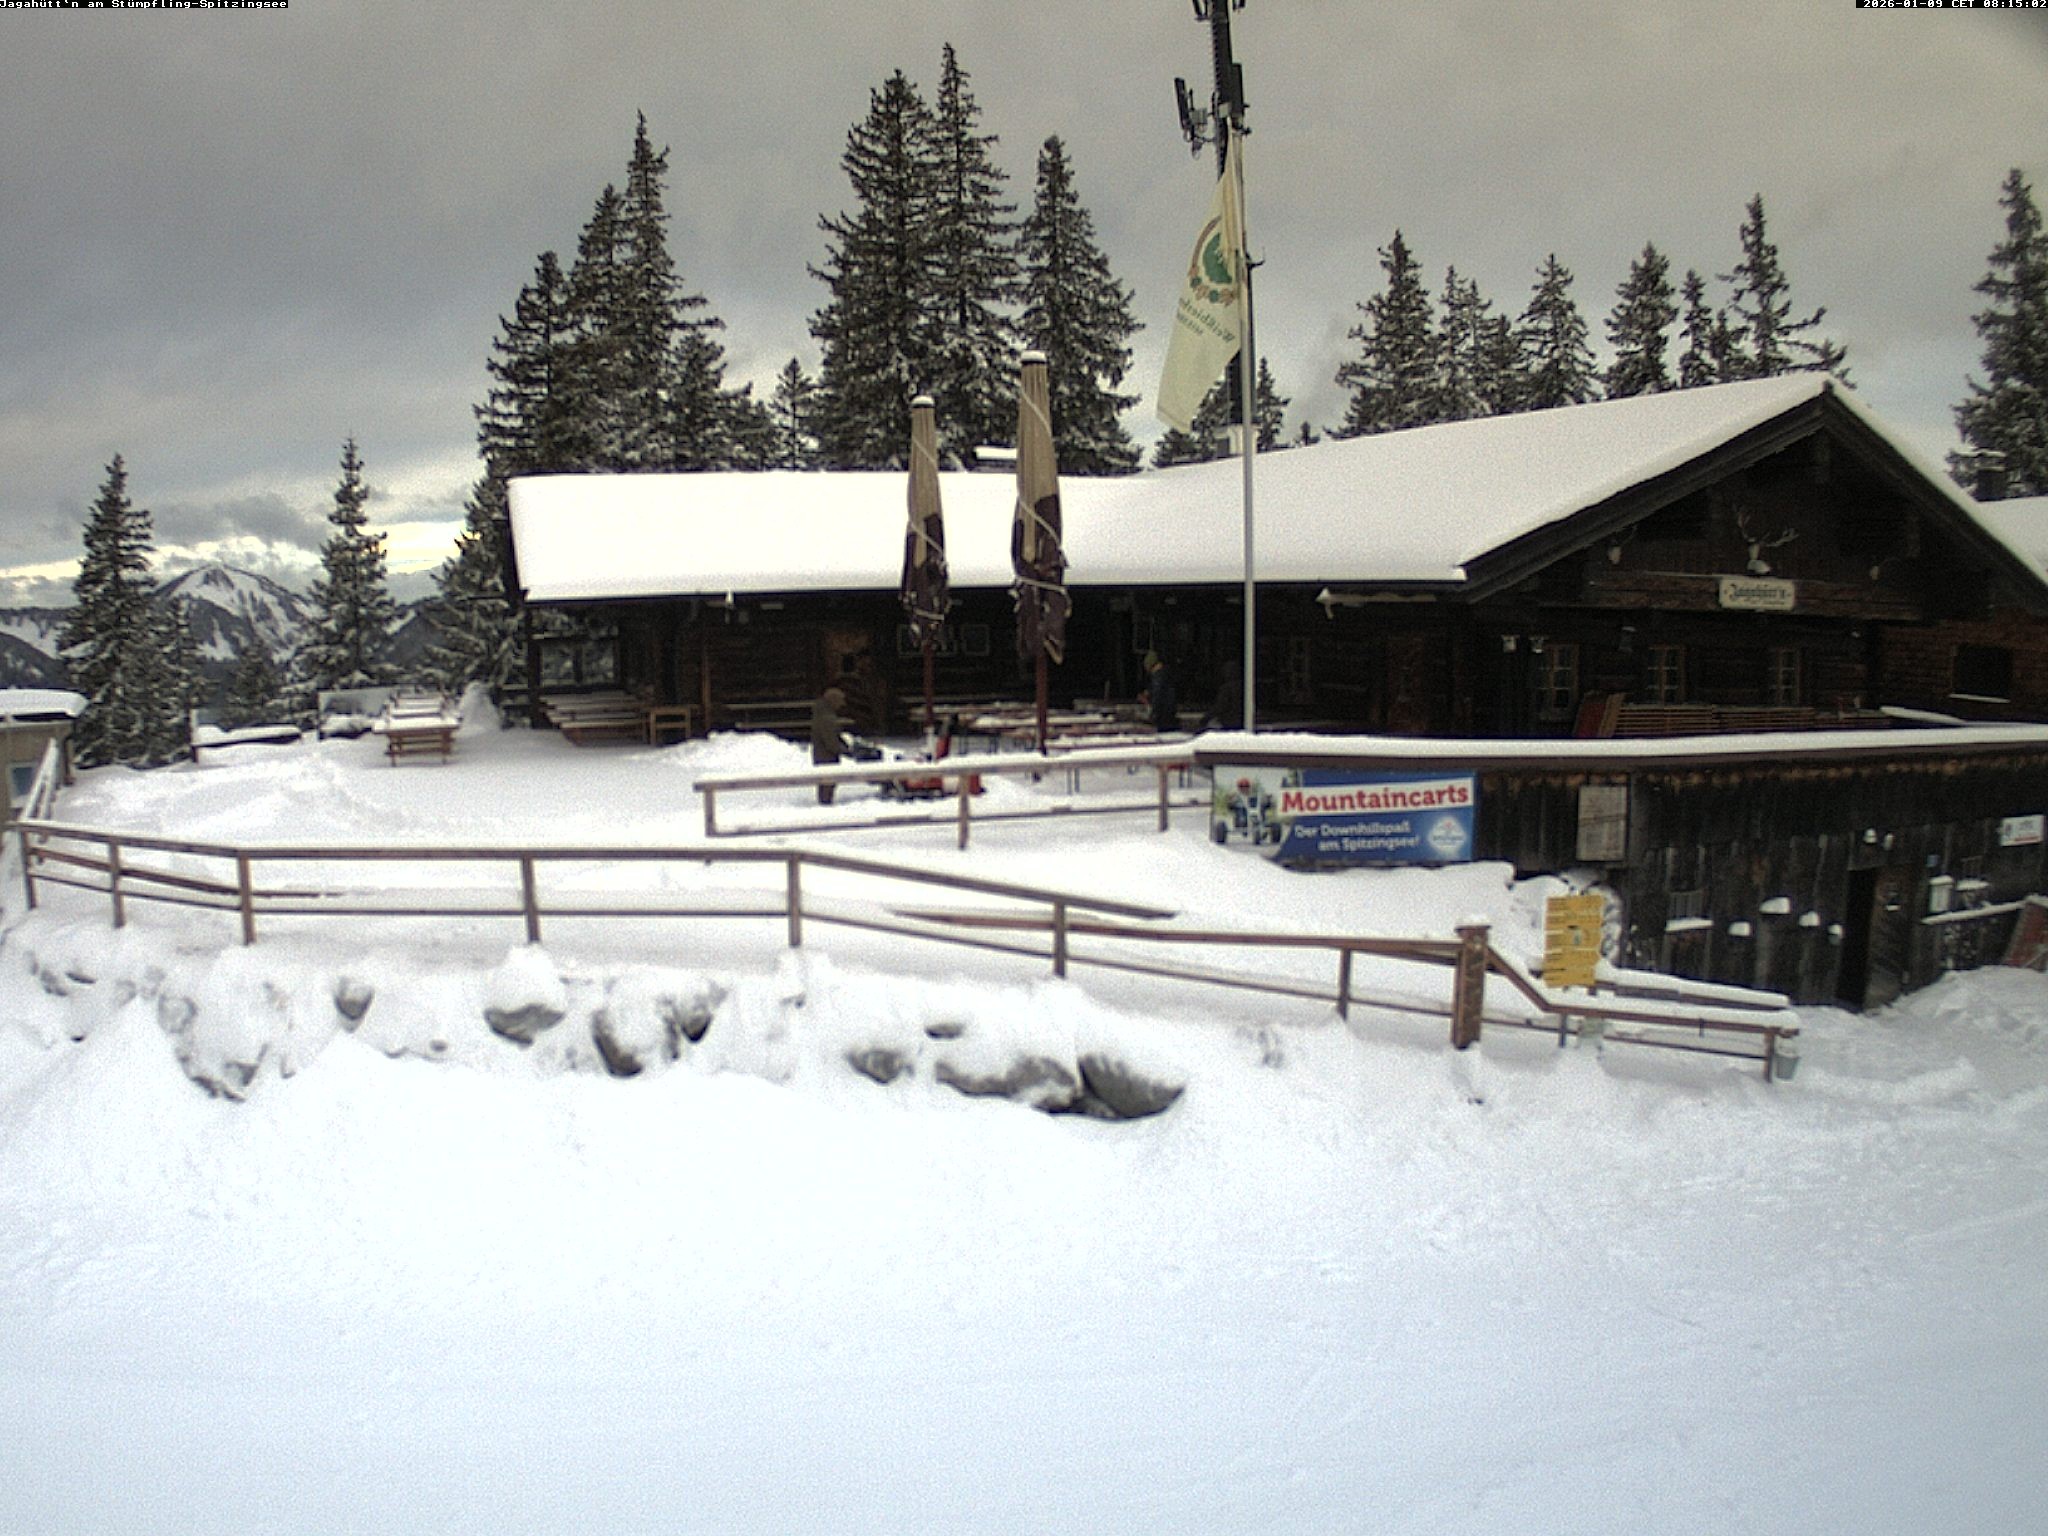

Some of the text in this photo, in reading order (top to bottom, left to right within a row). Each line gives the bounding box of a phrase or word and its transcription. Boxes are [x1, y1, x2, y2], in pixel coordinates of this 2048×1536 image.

[1281, 785, 1470, 814] Mountaincarts
[1294, 824, 1316, 838] Der
[1318, 840, 1341, 852] am
